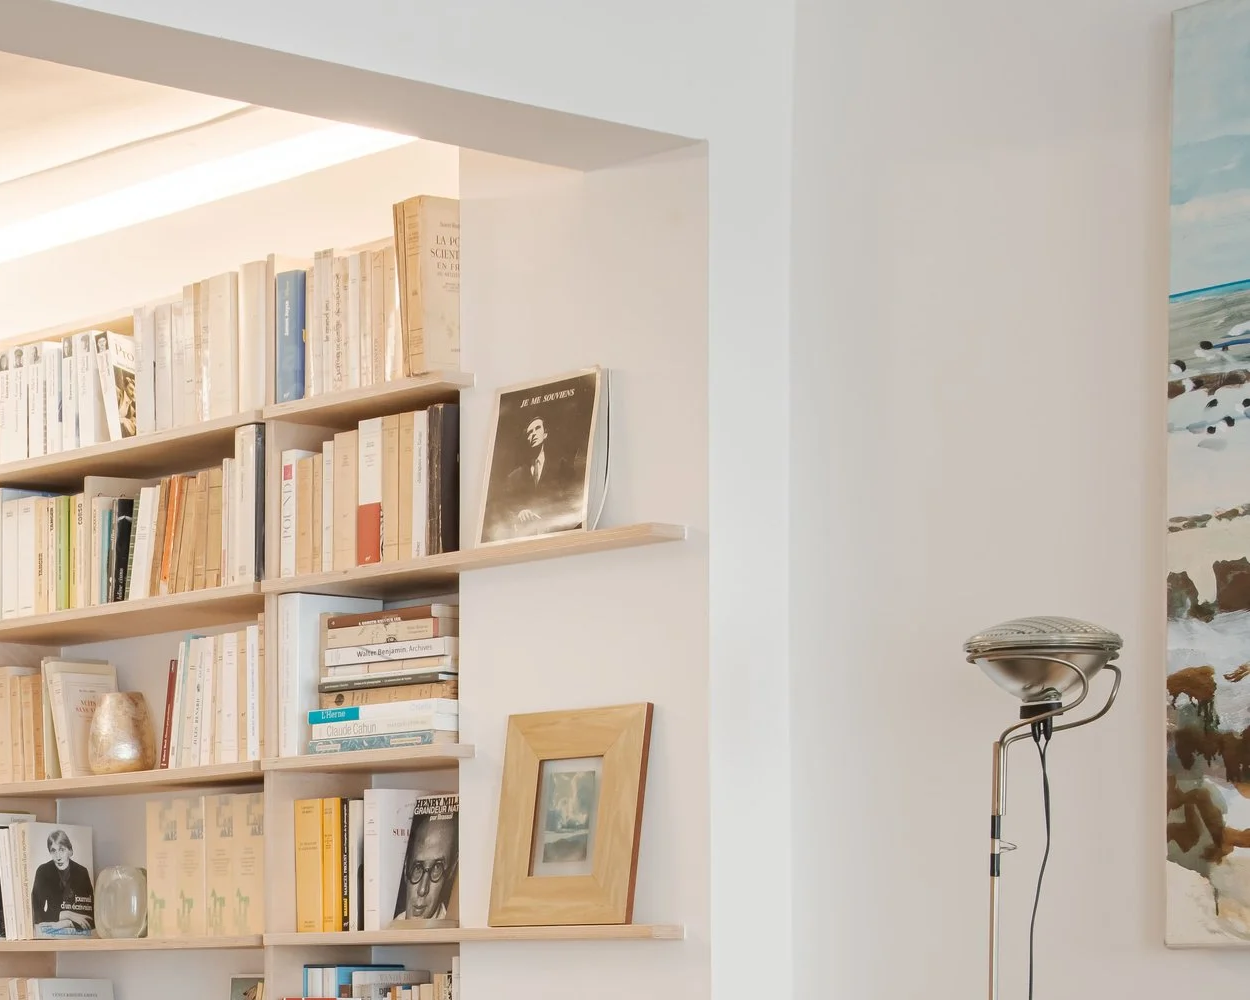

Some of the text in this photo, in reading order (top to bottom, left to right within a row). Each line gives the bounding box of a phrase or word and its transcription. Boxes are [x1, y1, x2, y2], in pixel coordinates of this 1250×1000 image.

[520, 388, 576, 409] JE ME SOUVIENS
[282, 483, 293, 539] POUND
[408, 642, 433, 653] Archives
[321, 709, 346, 720] L'Herne
[327, 724, 352, 738] Claude
[353, 722, 377, 735] Cahun
[416, 797, 442, 809] HENRY
[414, 803, 448, 816] GRANDEUR
[75, 894, 92, 904] journal
